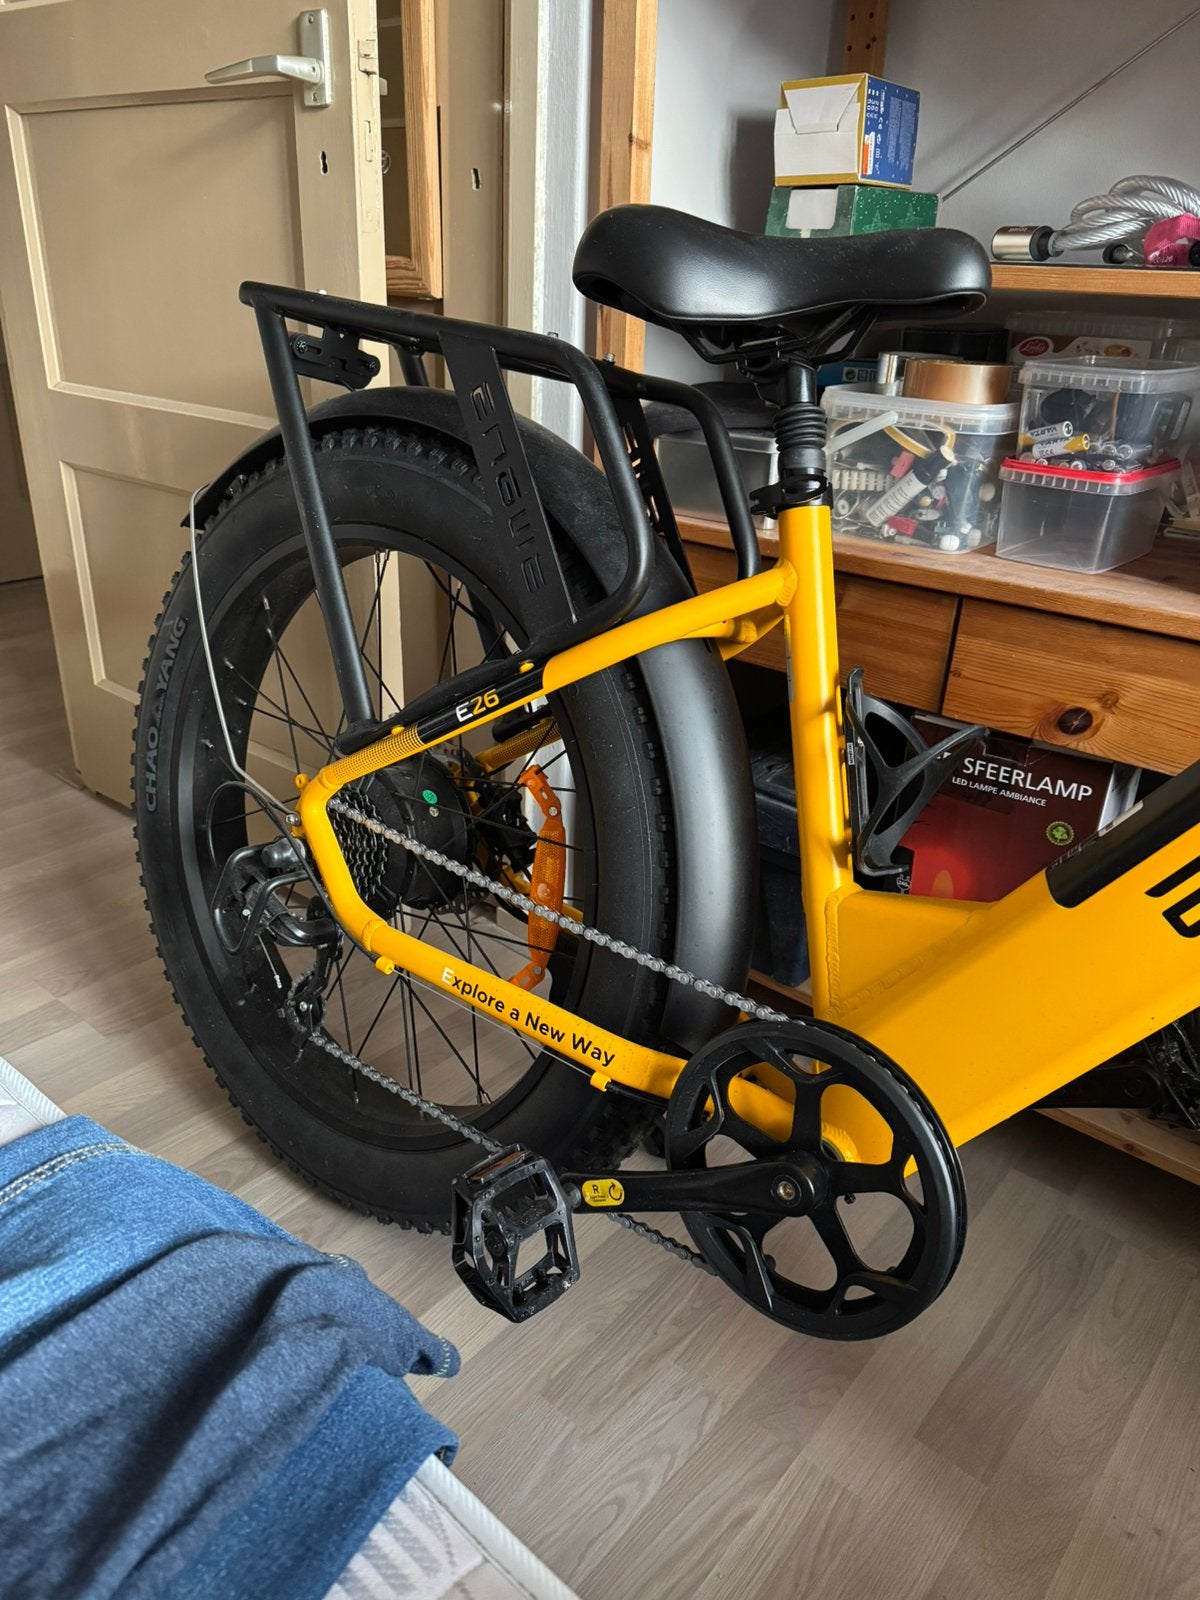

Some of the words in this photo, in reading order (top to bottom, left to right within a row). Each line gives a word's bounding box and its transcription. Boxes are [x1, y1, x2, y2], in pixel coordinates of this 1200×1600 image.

[1030, 426, 1058, 437] VARTA
[455, 688, 500, 722] E26
[952, 776, 968, 787] LED
[969, 779, 998, 795] LAMPE
[999, 789, 1047, 807] AMBIANCE
[962, 757, 1093, 801] SFEERLAMP
[441, 967, 505, 1013] Explore
[509, 1008, 520, 1022] a
[525, 1011, 566, 1043] New
[571, 1033, 616, 1067] Way
[592, 1184, 600, 1194] R
